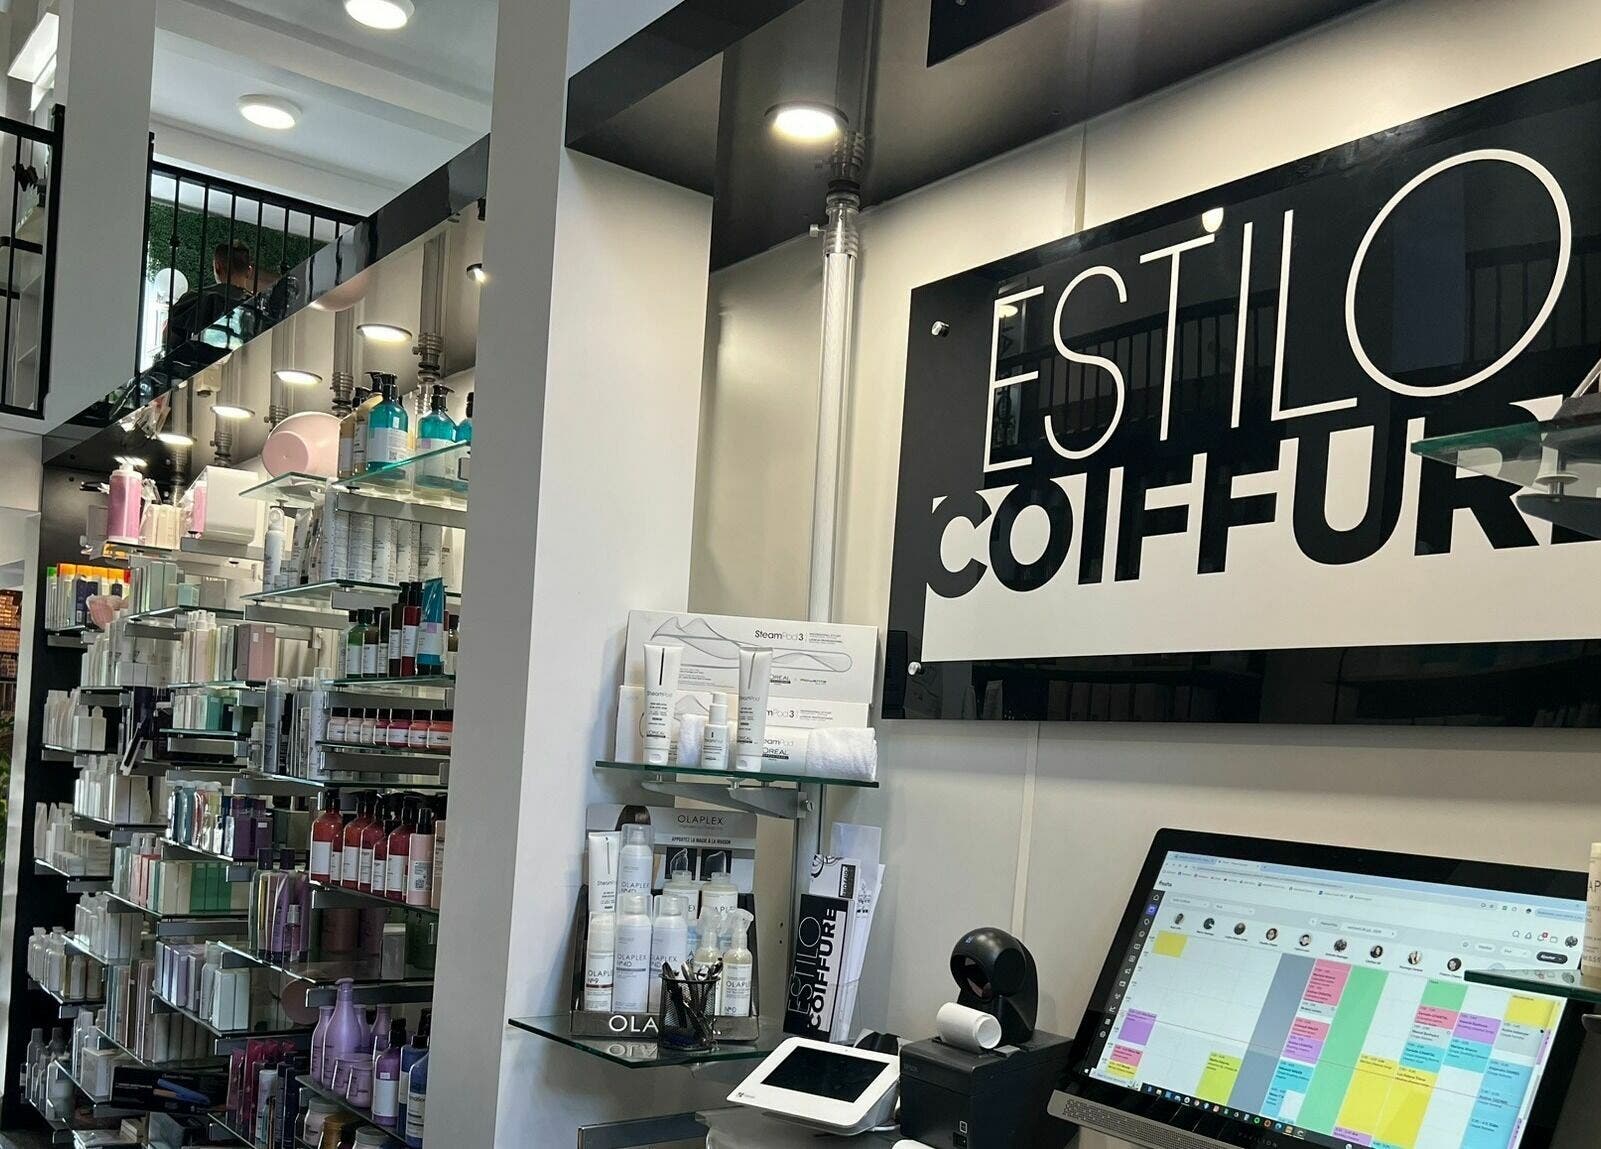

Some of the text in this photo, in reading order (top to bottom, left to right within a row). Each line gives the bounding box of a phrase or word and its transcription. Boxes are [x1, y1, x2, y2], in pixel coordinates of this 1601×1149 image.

[983, 148, 1571, 473] ESTILO
[925, 392, 1601, 599] COIFFUR
[798, 633, 804, 641] 3
[677, 814, 724, 825] OLAPLEX
[787, 916, 822, 1015] ESTILO
[808, 908, 837, 1031] COIFFURE
[608, 1014, 659, 1033] OLA
